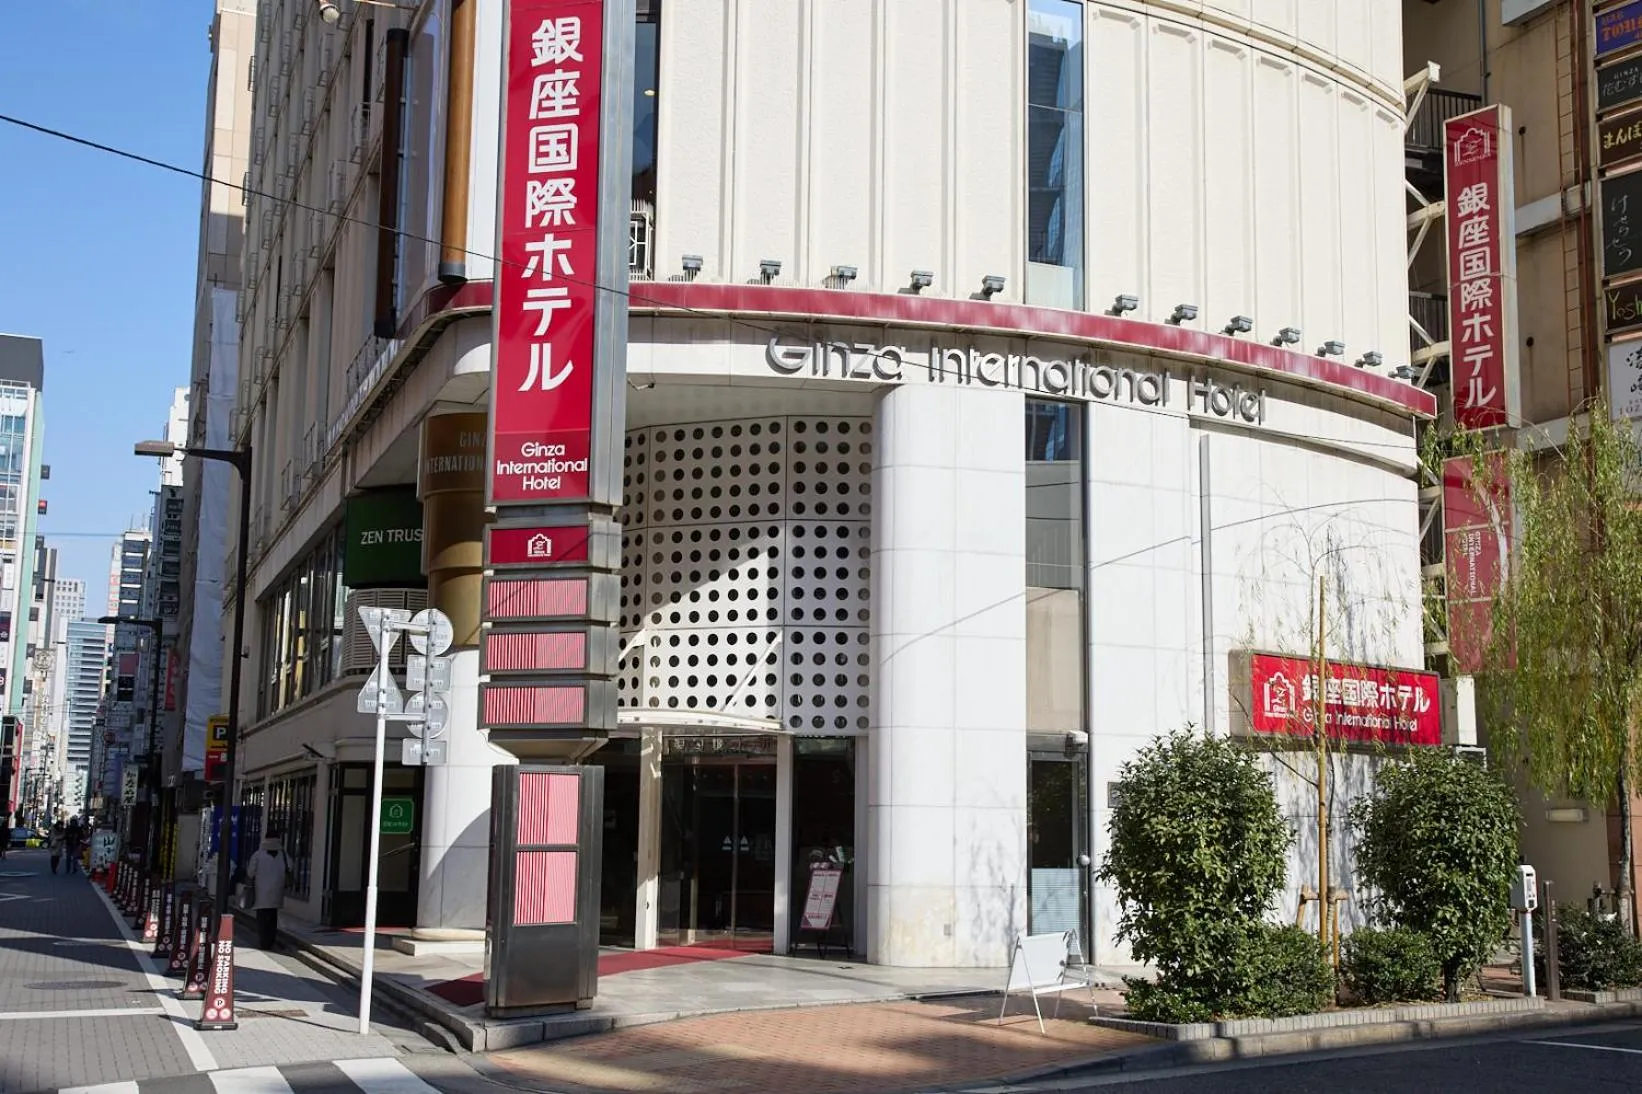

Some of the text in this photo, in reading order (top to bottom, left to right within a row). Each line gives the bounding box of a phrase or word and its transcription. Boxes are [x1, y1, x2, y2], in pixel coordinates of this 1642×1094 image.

[518, 16, 584, 393] 銀座国際ホテル
[1457, 182, 1497, 408] 銀座国際ホテル
[766, 338, 1267, 426] Ginza International Hotel
[521, 442, 566, 457] Ginza
[497, 458, 588, 475] International
[522, 475, 561, 491] Hotel
[360, 530, 383, 545] ZEN
[216, 727, 227, 739] P
[218, 940, 225, 954] NO
[224, 940, 232, 954] NO
